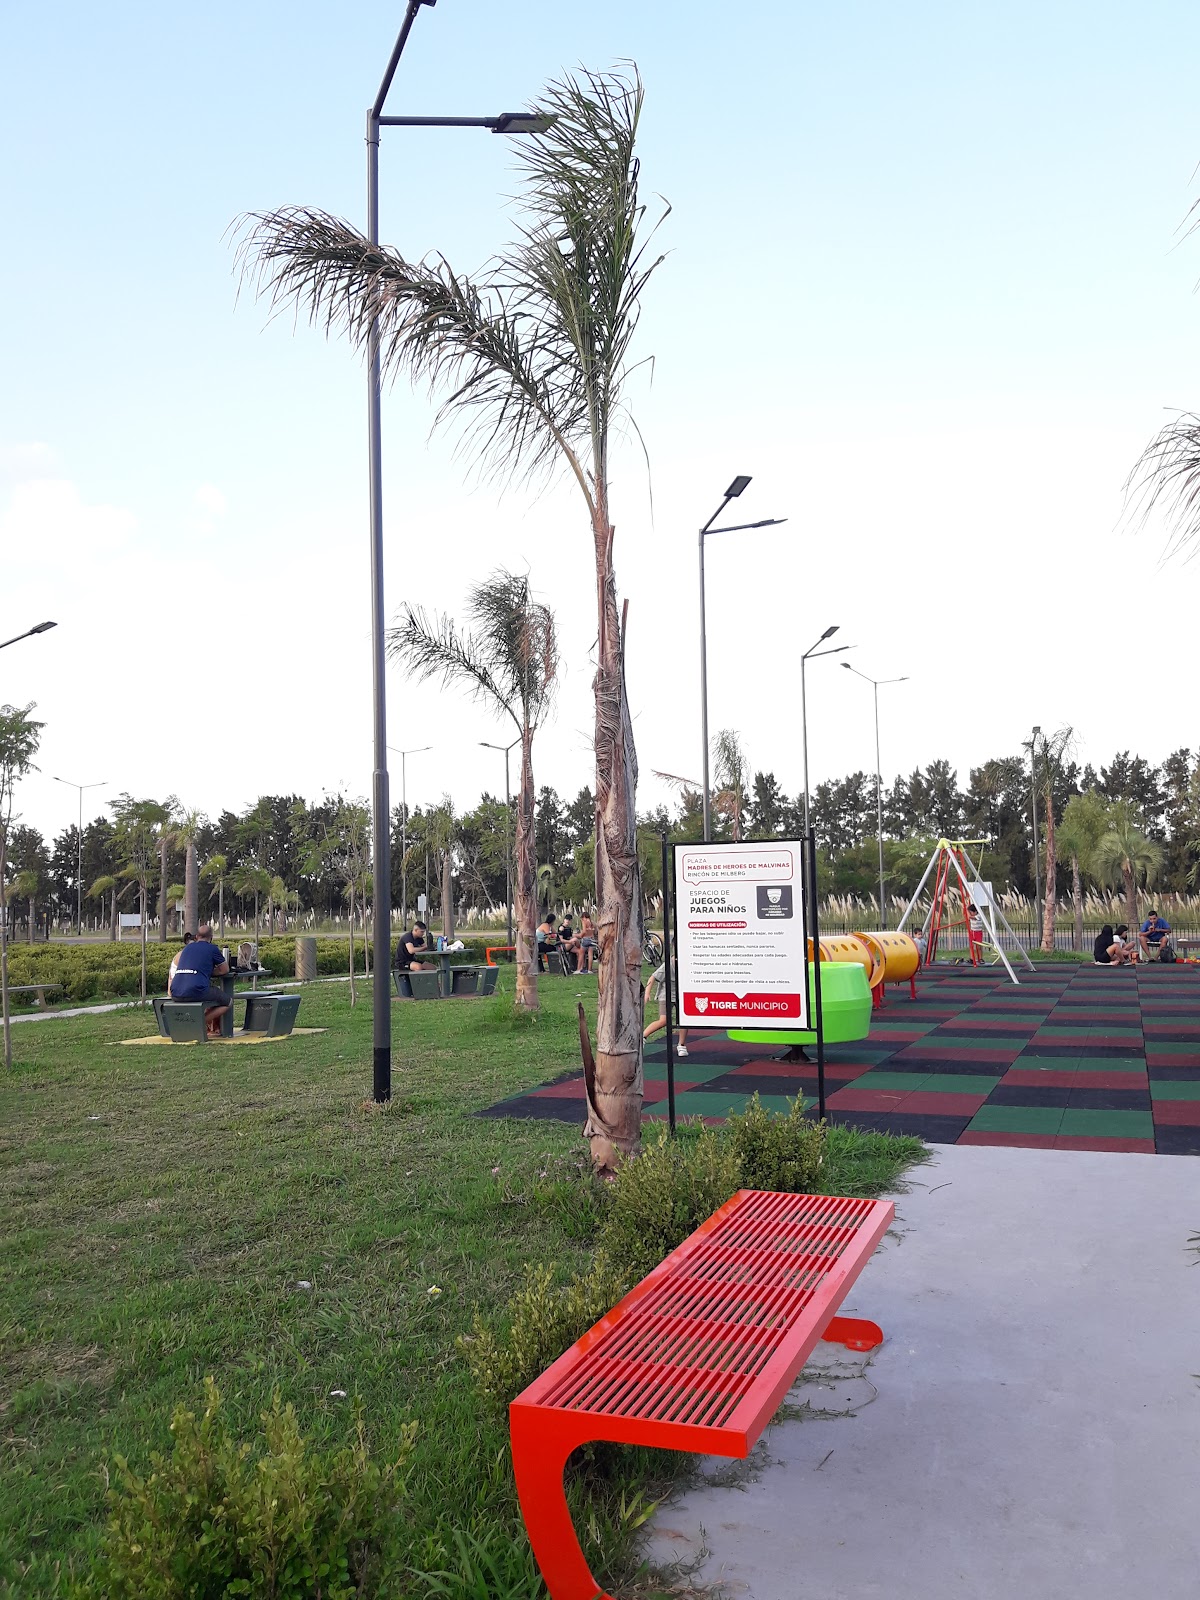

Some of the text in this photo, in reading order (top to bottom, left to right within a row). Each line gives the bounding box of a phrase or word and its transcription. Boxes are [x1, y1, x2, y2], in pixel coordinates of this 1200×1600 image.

[689, 897, 726, 905] JUEGOS
[690, 904, 747, 914] PARA NIÑOS
[710, 1001, 789, 1011] TIGRE MUNICIPIO
